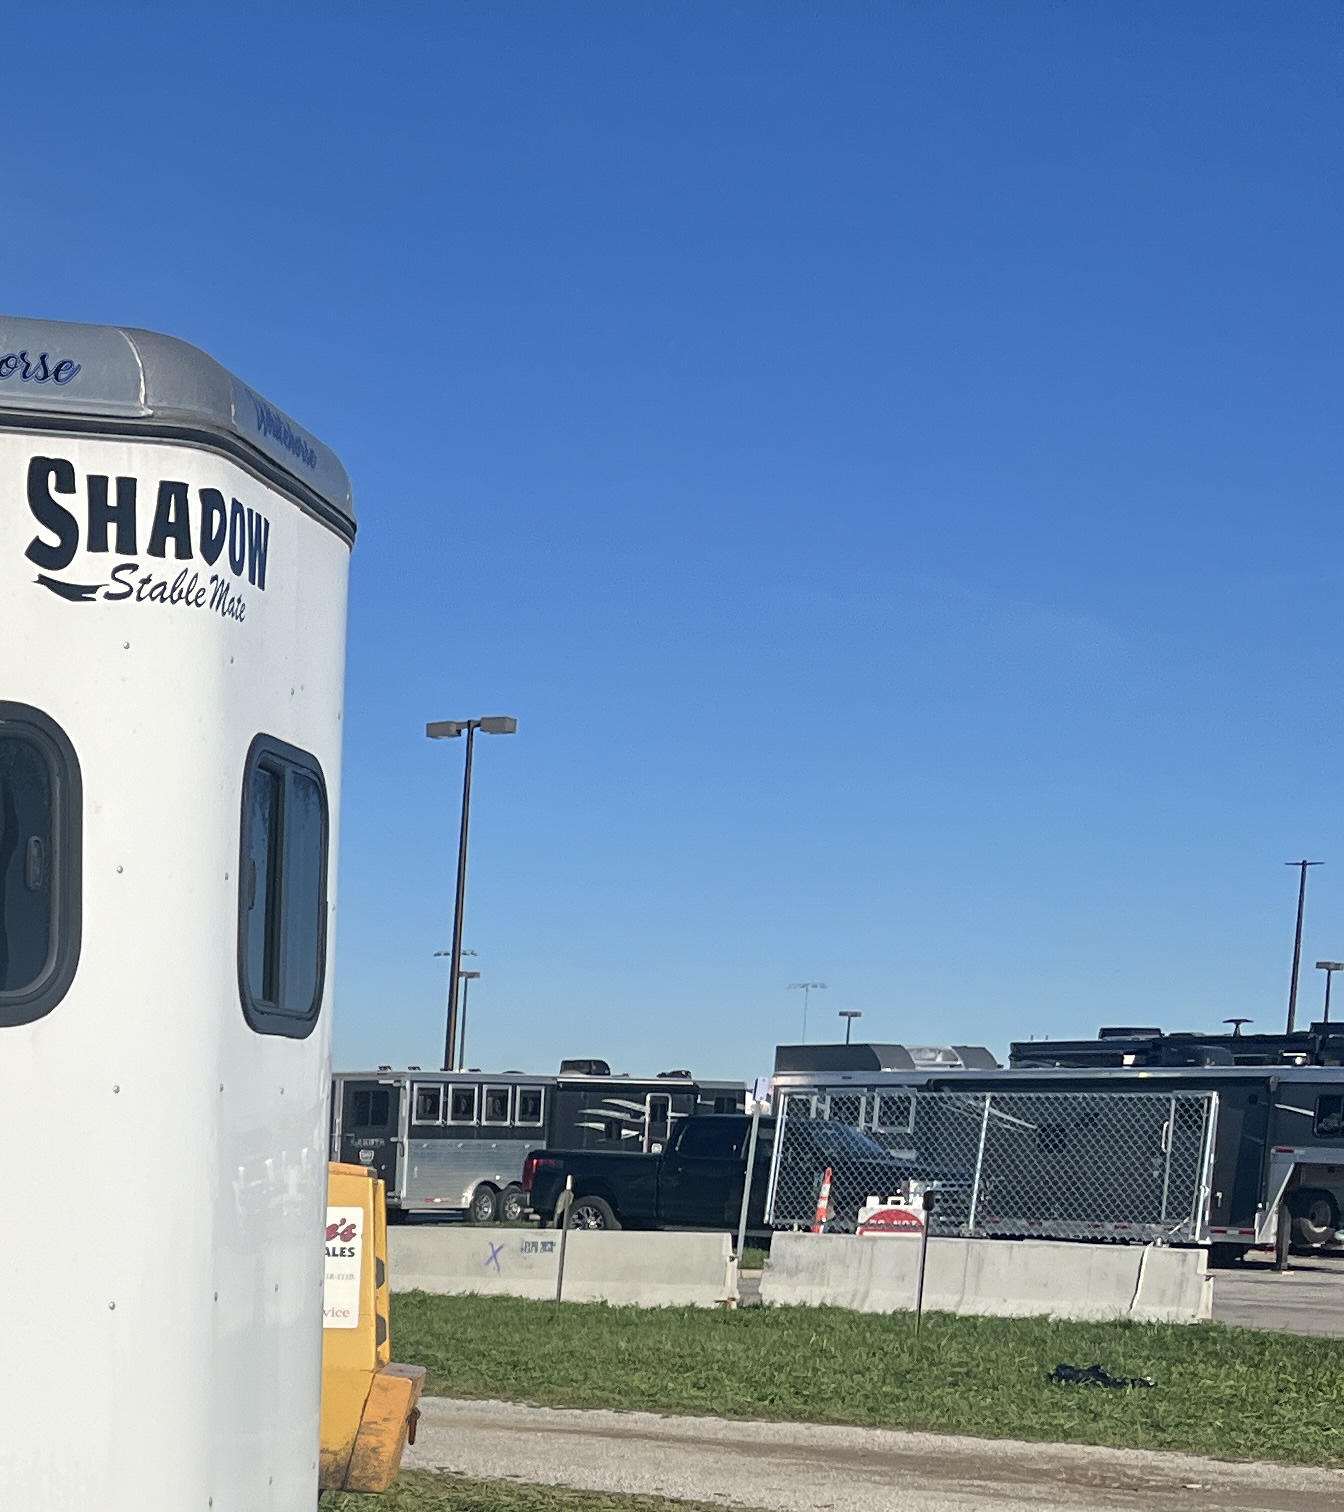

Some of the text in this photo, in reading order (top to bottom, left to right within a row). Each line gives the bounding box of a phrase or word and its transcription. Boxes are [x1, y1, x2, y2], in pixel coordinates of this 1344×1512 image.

[24, 455, 270, 592] SHADOW
[102, 563, 246, 623] Stable Mate
